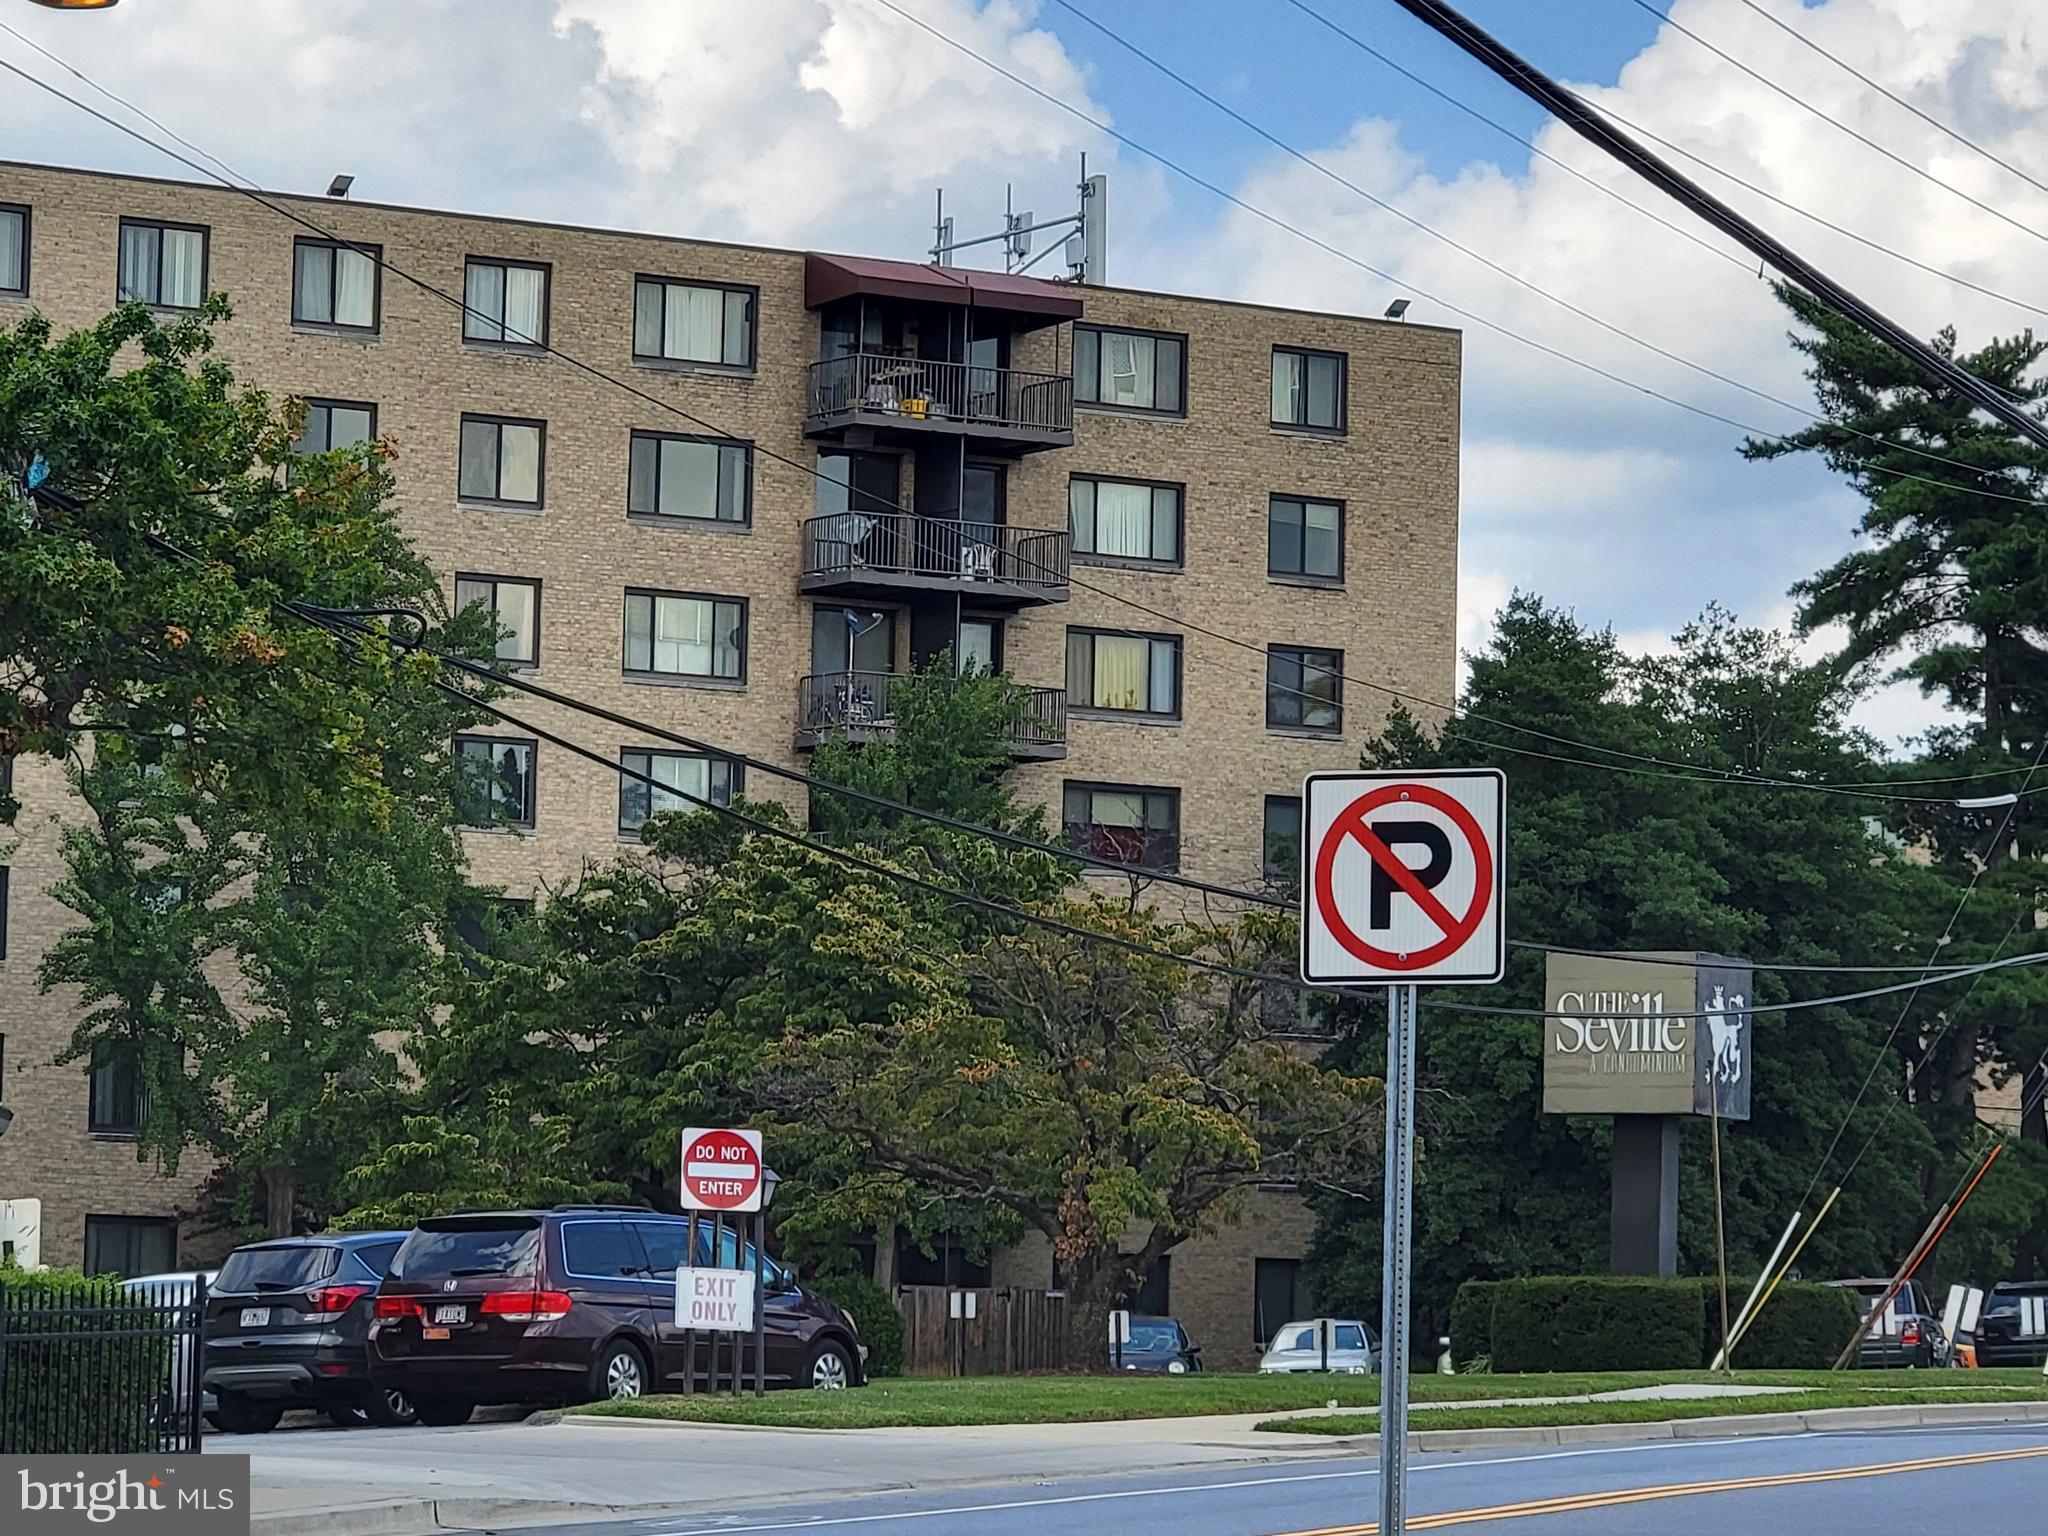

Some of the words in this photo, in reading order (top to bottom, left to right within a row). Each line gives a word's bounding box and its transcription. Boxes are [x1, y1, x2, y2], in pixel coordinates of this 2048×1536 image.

[1370, 821, 1452, 930] P
[1589, 991, 1630, 1014] THE
[1555, 991, 1686, 1053] Seville
[1589, 1054, 1597, 1073] A
[696, 1145, 715, 1160] DO
[721, 1146, 748, 1161] NOT
[699, 1180, 743, 1196] ENTER
[694, 1276, 736, 1298] EXIT
[691, 1300, 737, 1322] ONLY
